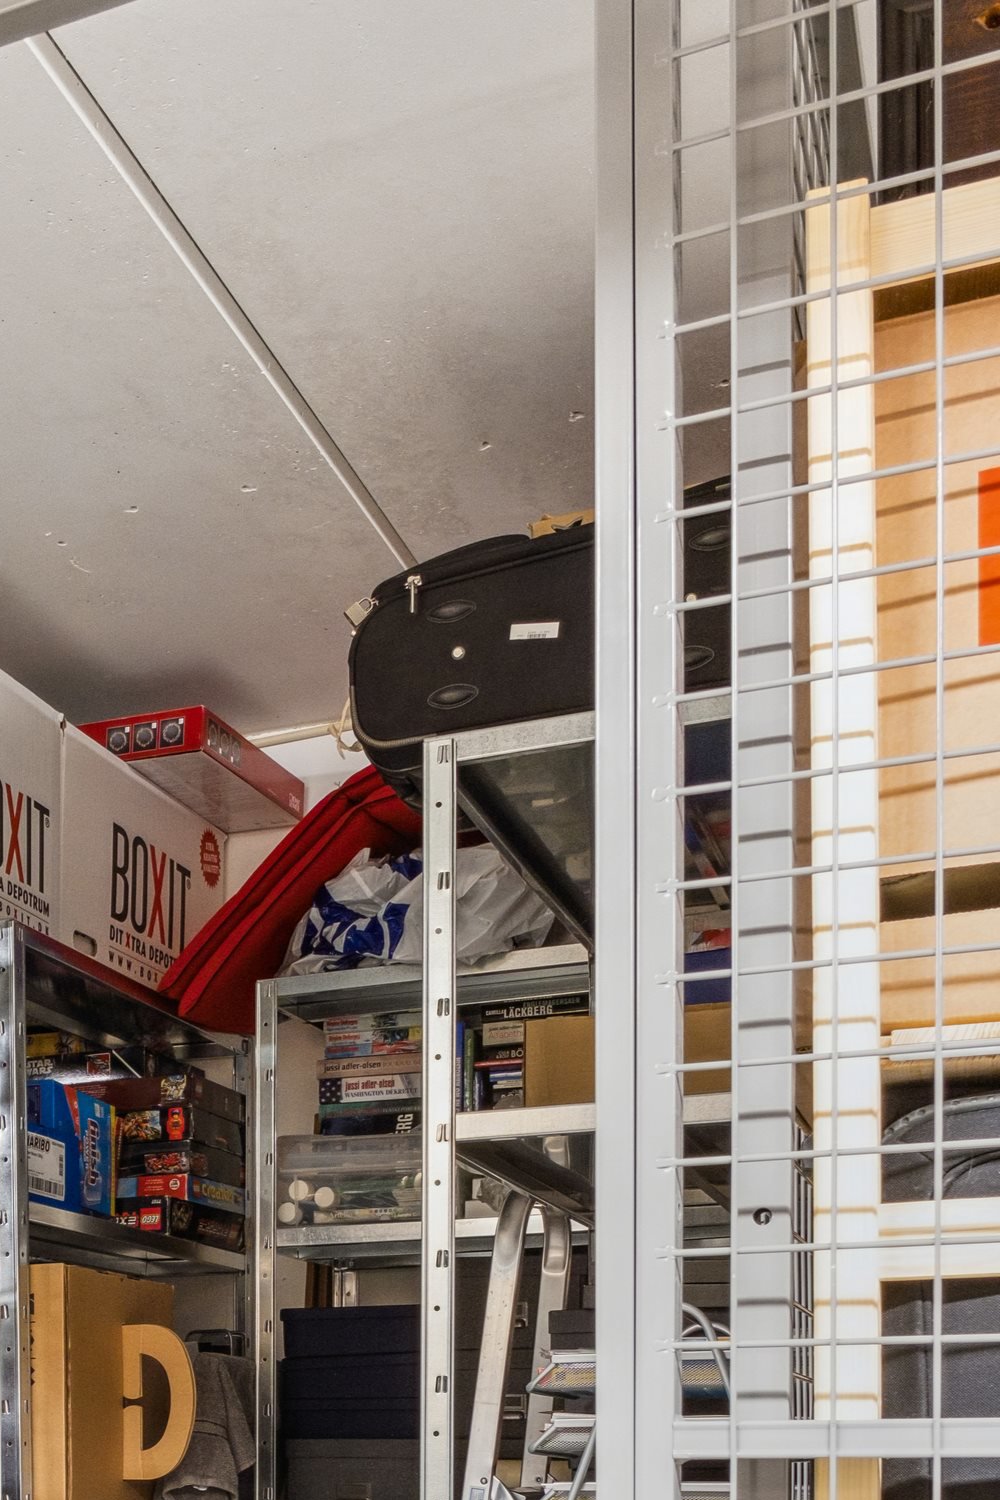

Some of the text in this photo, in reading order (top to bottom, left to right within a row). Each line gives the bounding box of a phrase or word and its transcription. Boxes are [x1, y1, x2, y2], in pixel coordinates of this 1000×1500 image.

[7, 880, 50, 917] DEPOTRUM
[110, 822, 191, 955] BOXIT
[109, 924, 124, 945] DIT
[125, 932, 146, 960] XTRA
[503, 1005, 553, 1018] LÄCKBERG
[324, 1063, 340, 1073] jussi
[342, 1061, 381, 1070] adler-olsen
[344, 1080, 360, 1092] jussi
